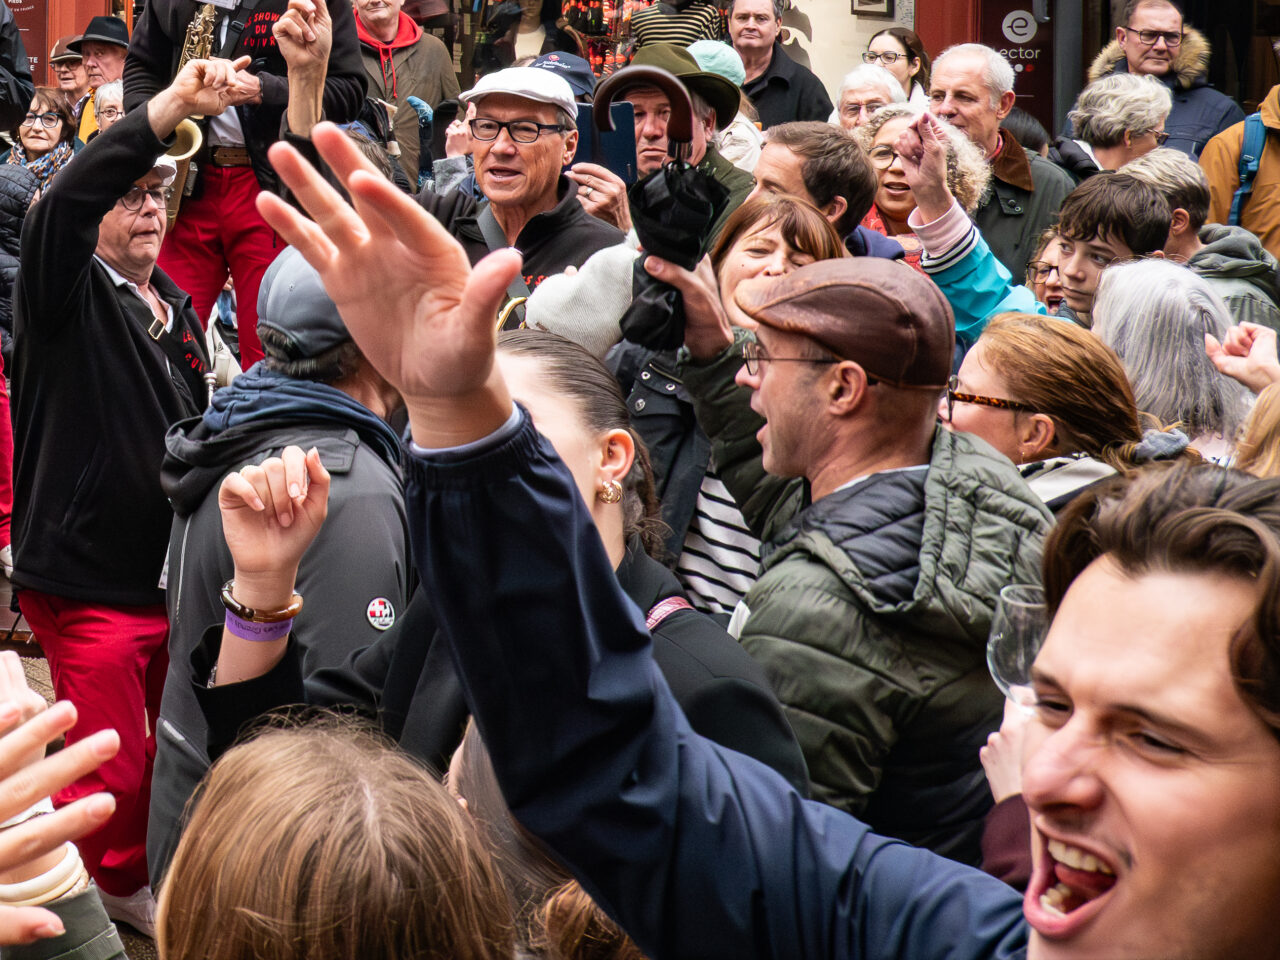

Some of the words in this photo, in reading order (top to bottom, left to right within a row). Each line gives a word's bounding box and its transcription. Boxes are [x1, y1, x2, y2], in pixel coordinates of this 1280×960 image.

[253, 12, 280, 22] SHOW
[255, 24, 267, 35] DU
[243, 36, 276, 47] CUIVR
